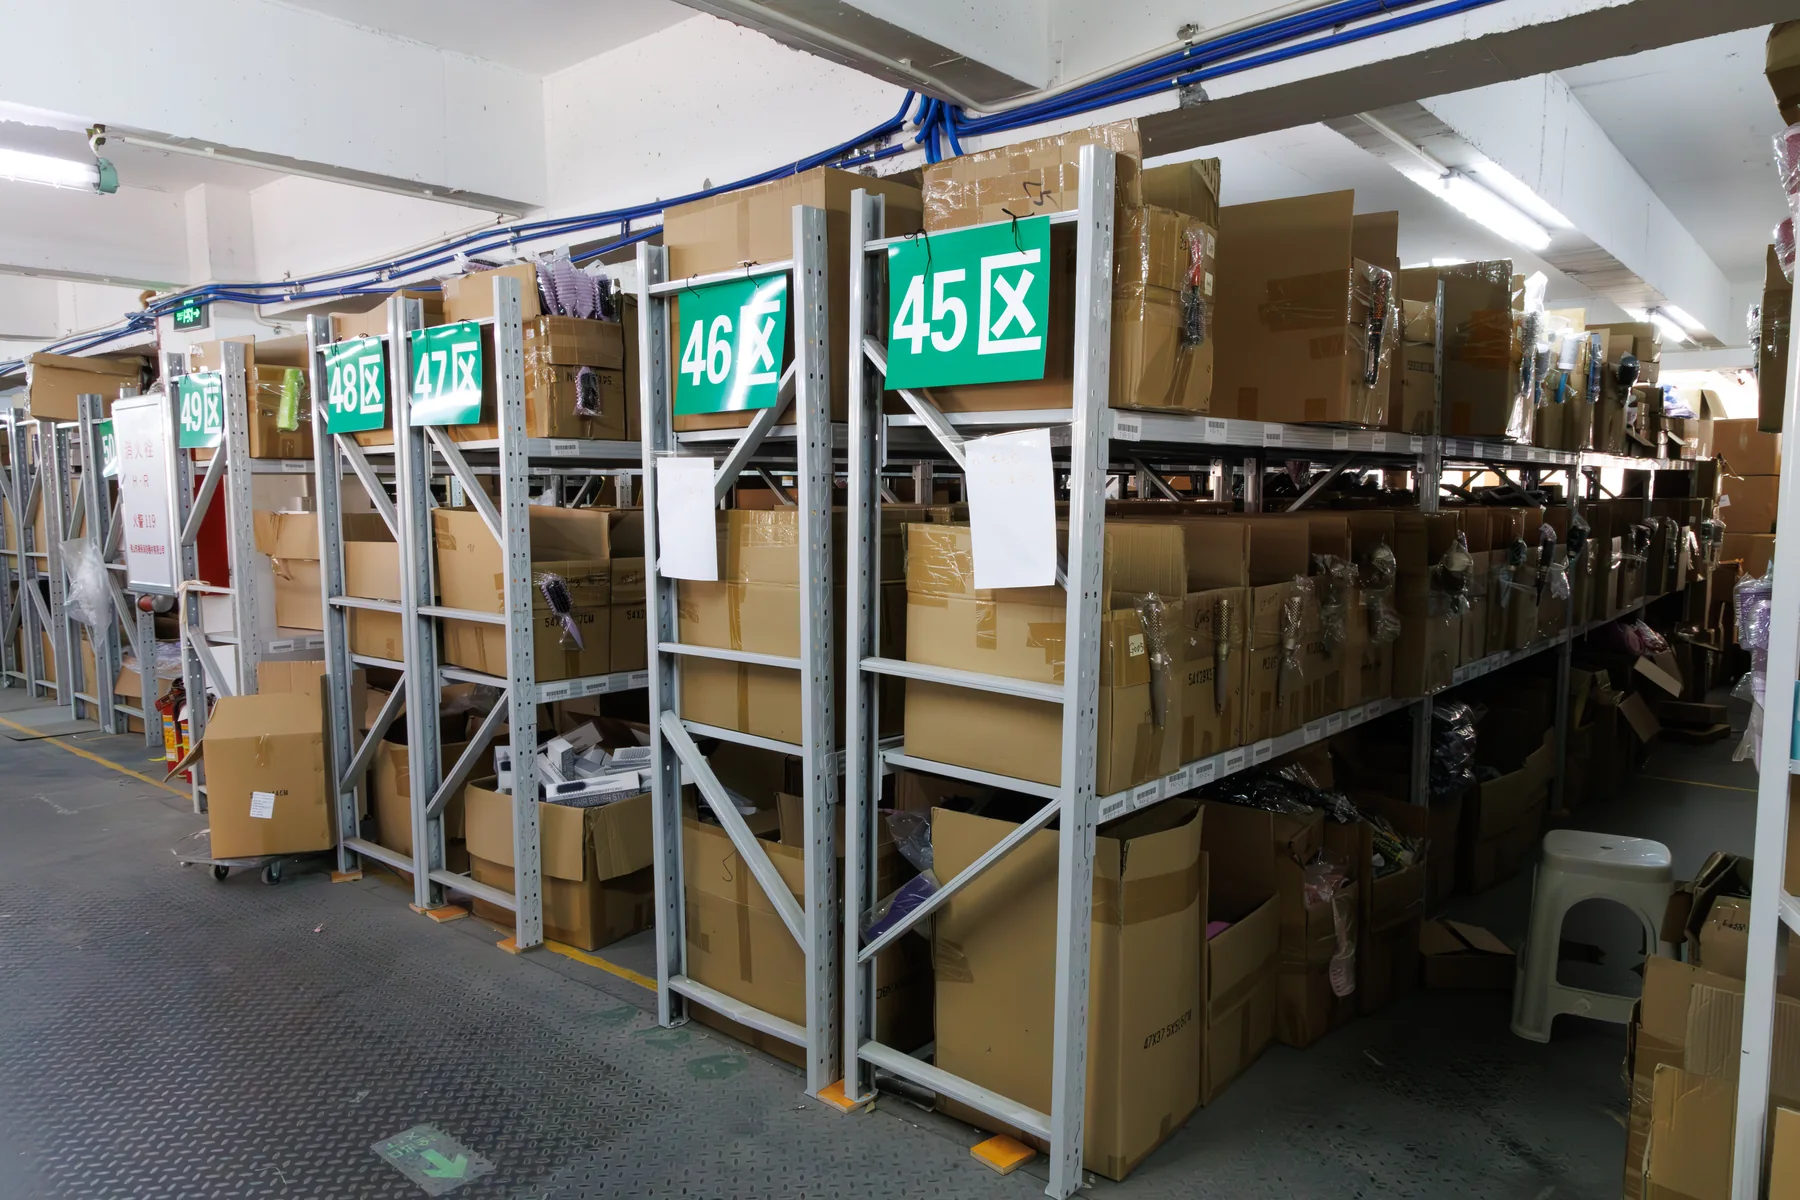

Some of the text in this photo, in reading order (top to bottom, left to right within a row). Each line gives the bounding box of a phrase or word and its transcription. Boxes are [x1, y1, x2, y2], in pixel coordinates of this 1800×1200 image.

[892, 248, 1042, 355] 45区
[414, 341, 479, 409] 47区
[680, 300, 780, 387] 46区
[181, 386, 221, 434] 49区
[329, 355, 383, 414] 48区
